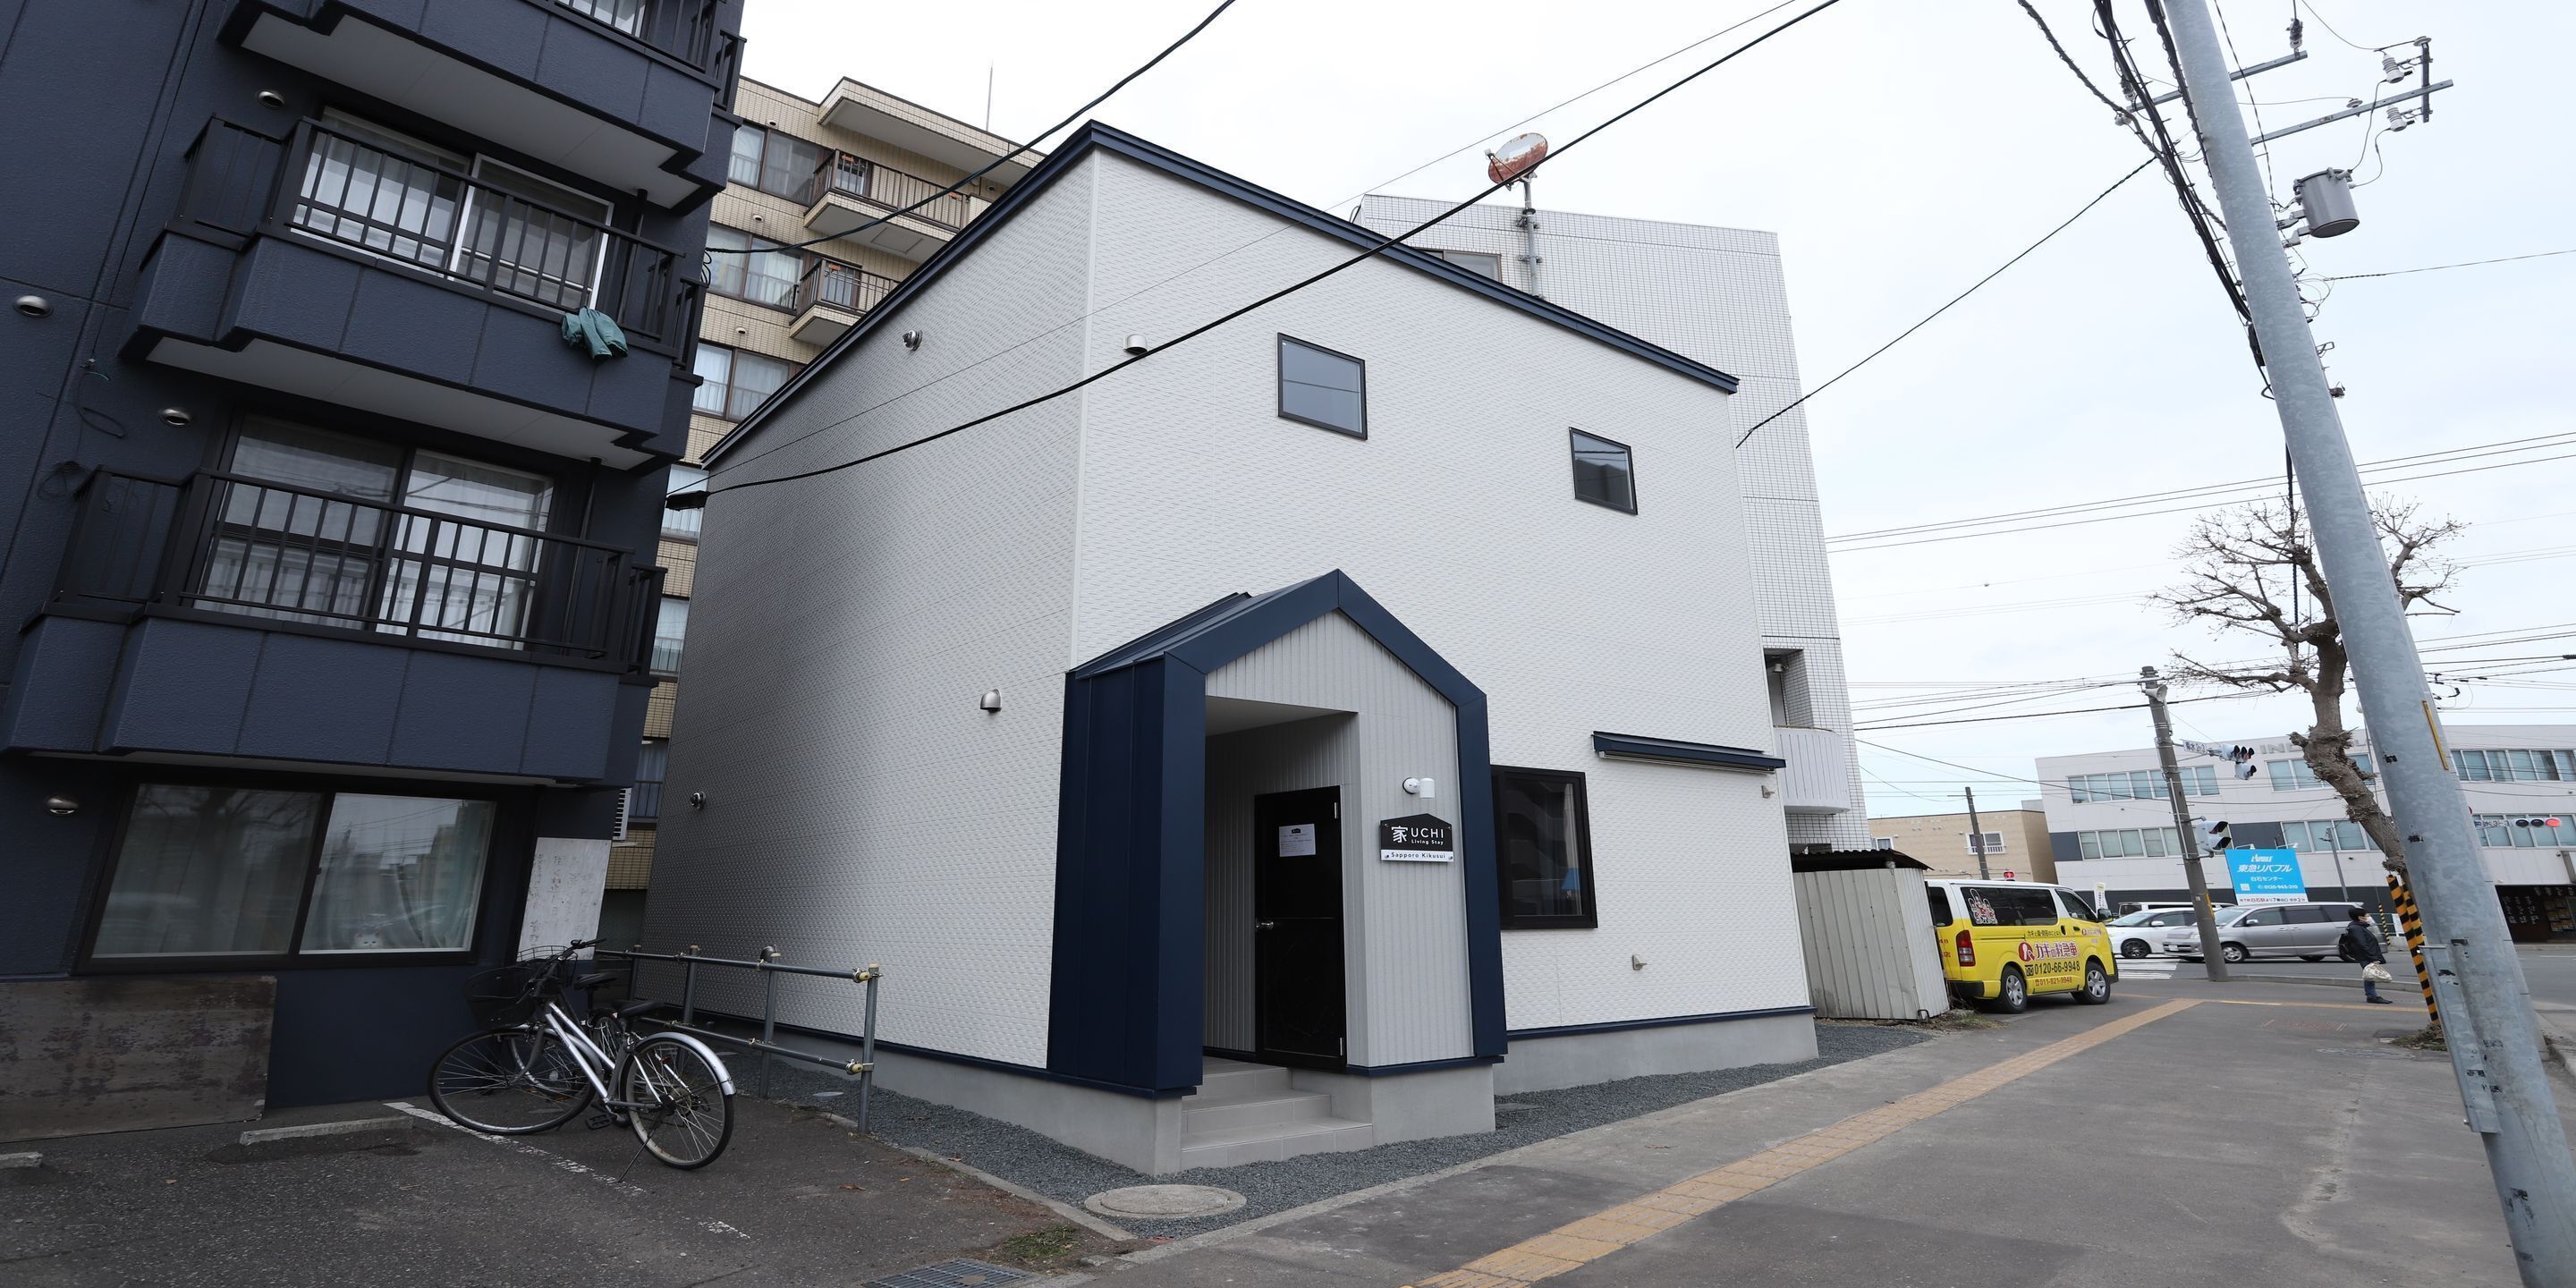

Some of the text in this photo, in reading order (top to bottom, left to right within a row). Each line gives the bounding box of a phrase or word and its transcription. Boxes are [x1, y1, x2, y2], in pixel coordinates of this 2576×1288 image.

[1391, 826, 1409, 843] 家
[1411, 827, 1444, 838] UCHI
[2238, 865, 2292, 873] 東急リバブル
[2034, 942, 2078, 958] カギの救急車
[2034, 961, 2080, 975] 0120-66-9948
